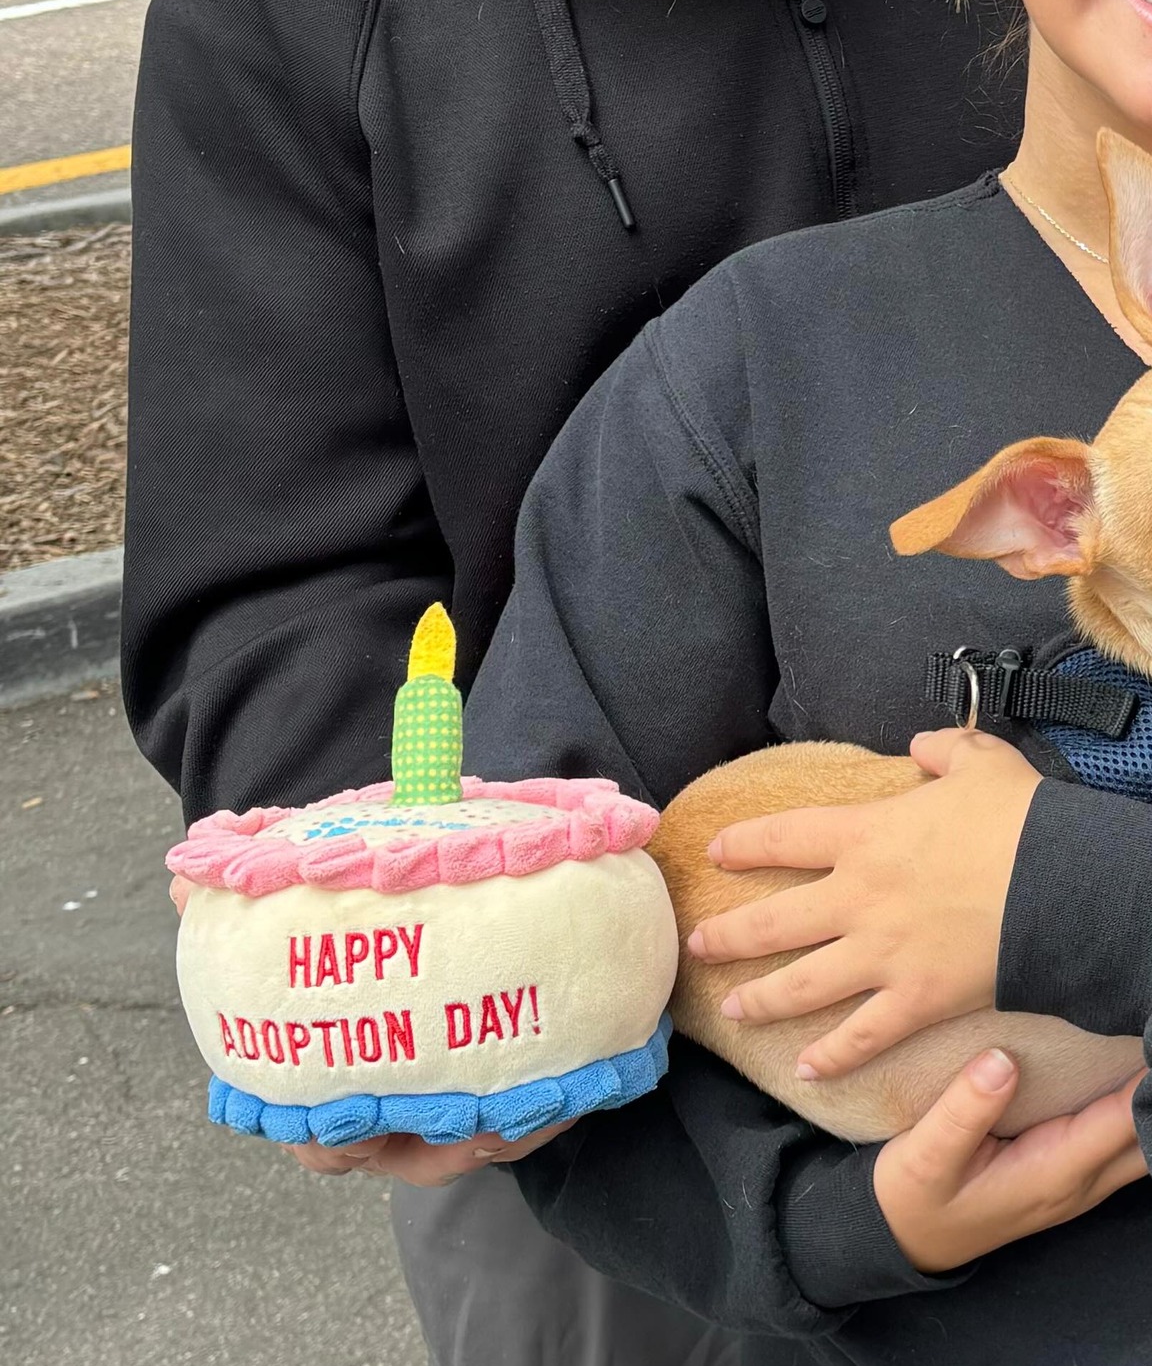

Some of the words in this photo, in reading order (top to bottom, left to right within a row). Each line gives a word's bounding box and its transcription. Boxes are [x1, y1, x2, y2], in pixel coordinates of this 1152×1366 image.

[288, 923, 424, 989] HAPPY
[217, 1010, 416, 1067] ADOPTION
[445, 985, 541, 1050] DAY!
